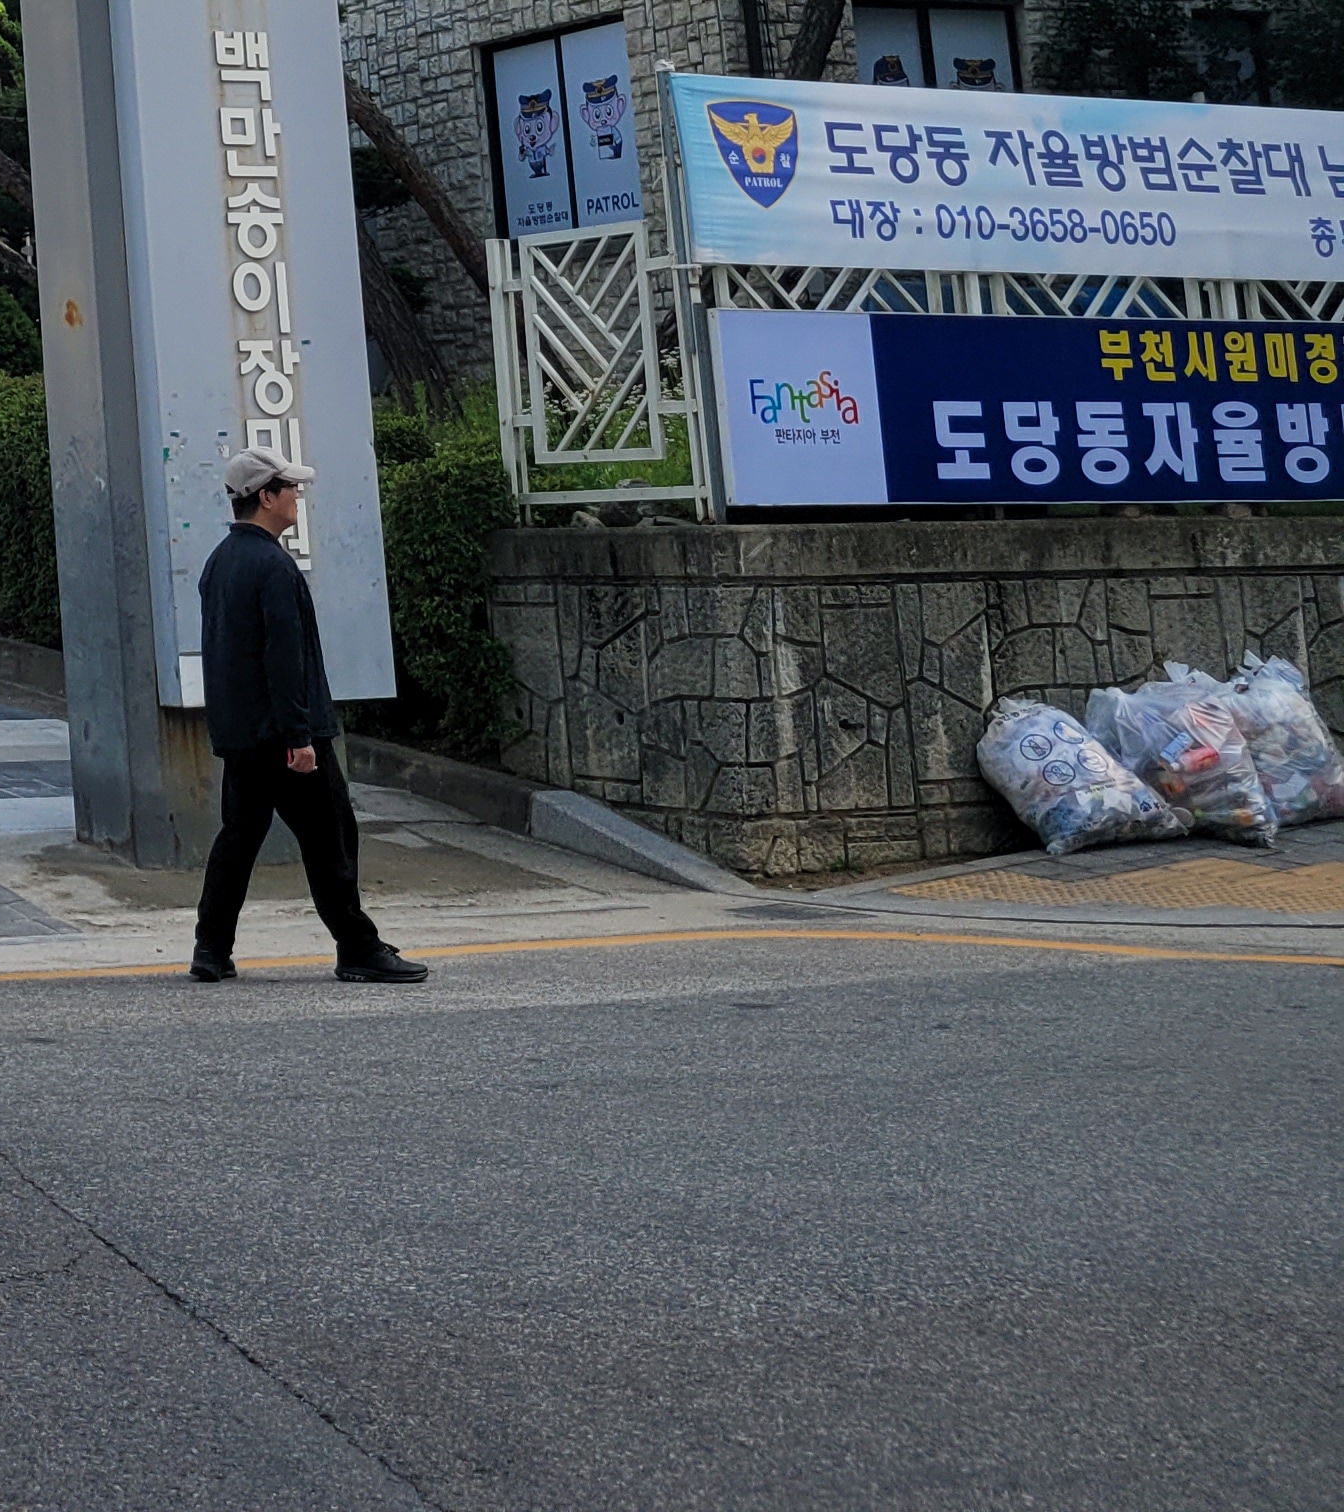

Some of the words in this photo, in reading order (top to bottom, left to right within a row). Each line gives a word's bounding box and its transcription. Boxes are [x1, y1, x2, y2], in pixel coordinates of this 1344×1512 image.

[728, 149, 740, 165] 순
[824, 121, 970, 187] 도당동
[984, 129, 1312, 197] 자율방범순찰대
[744, 176, 784, 188] PATROL
[527, 201, 554, 215] 도당동
[586, 192, 640, 215] PATROL
[829, 199, 901, 241] 대장
[935, 203, 1177, 246] 010-3658-0650
[1309, 216, 1344, 258] 총
[1099, 329, 1344, 384] 부천시원미경
[749, 370, 860, 425] Fantasia
[775, 428, 817, 444] 판타지아
[819, 429, 841, 444] 부천
[932, 401, 1344, 486] 도당동자율방
